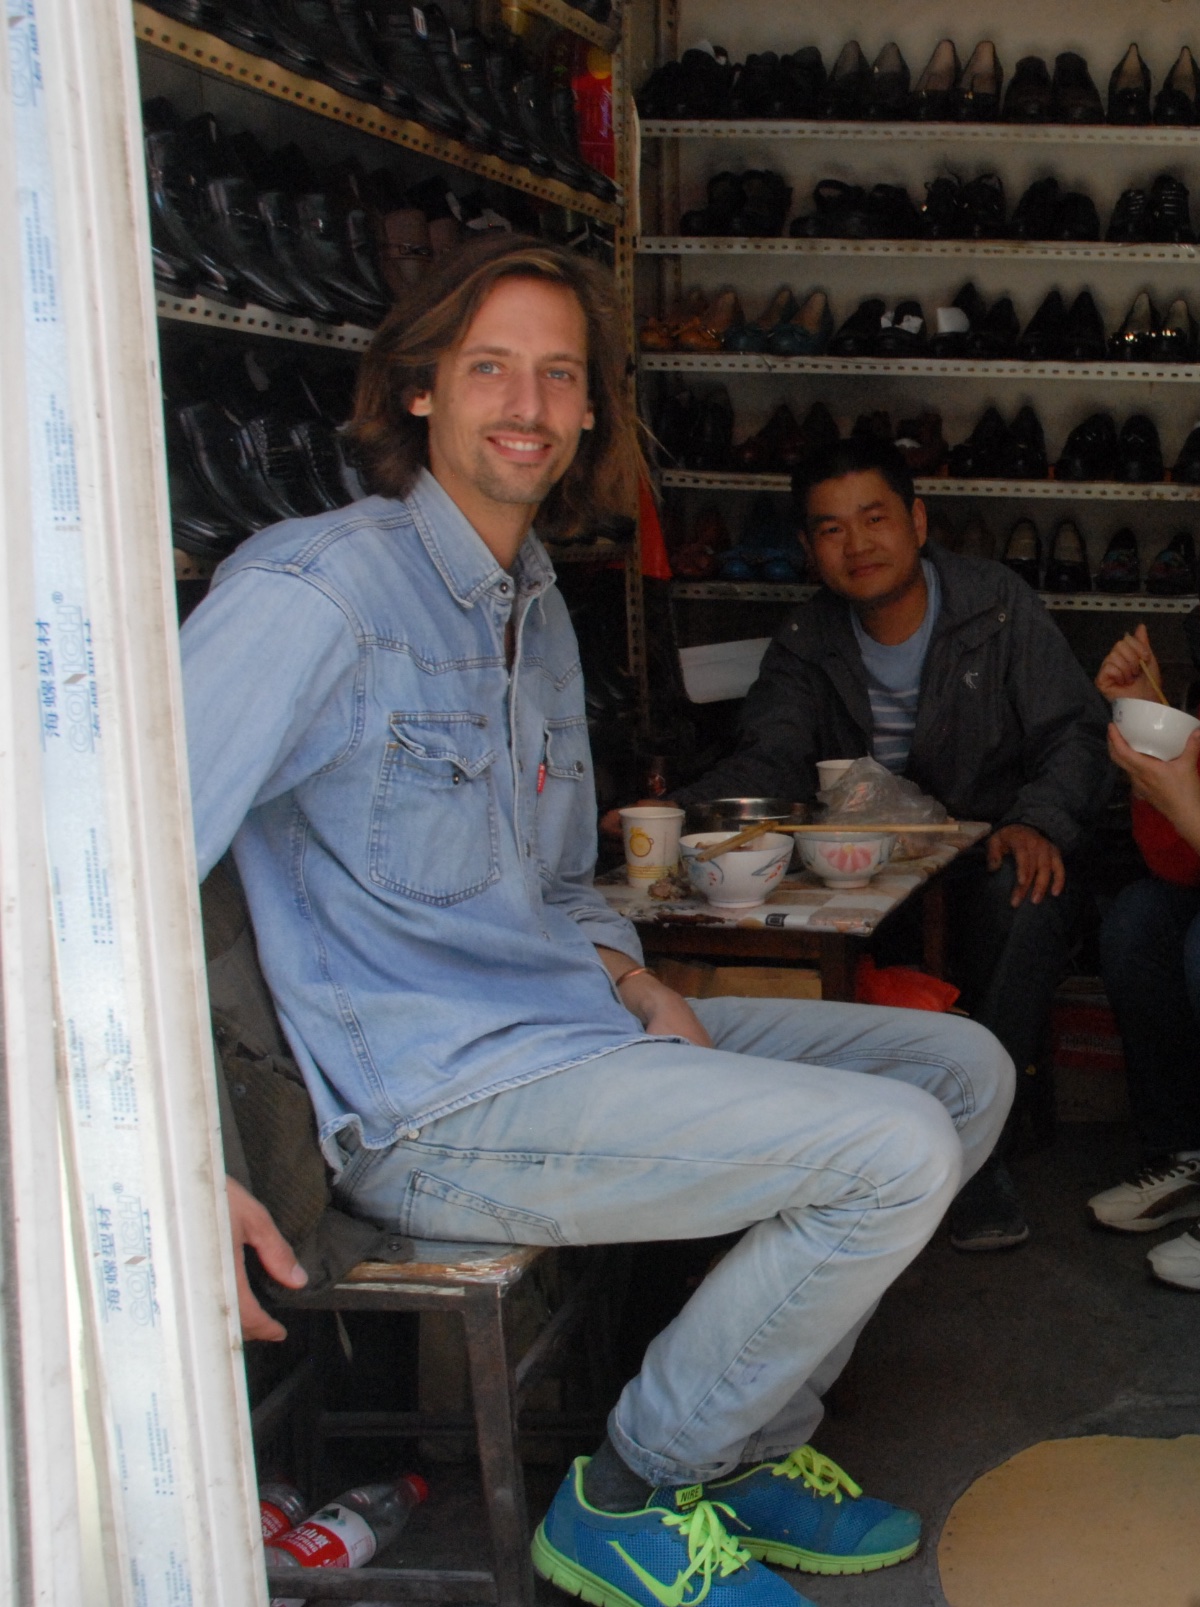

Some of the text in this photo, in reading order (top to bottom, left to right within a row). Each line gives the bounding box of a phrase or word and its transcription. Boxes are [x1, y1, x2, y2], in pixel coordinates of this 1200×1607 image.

[35, 617, 61, 738] 海螺型材
[97, 1205, 122, 1312] 海螺型材
